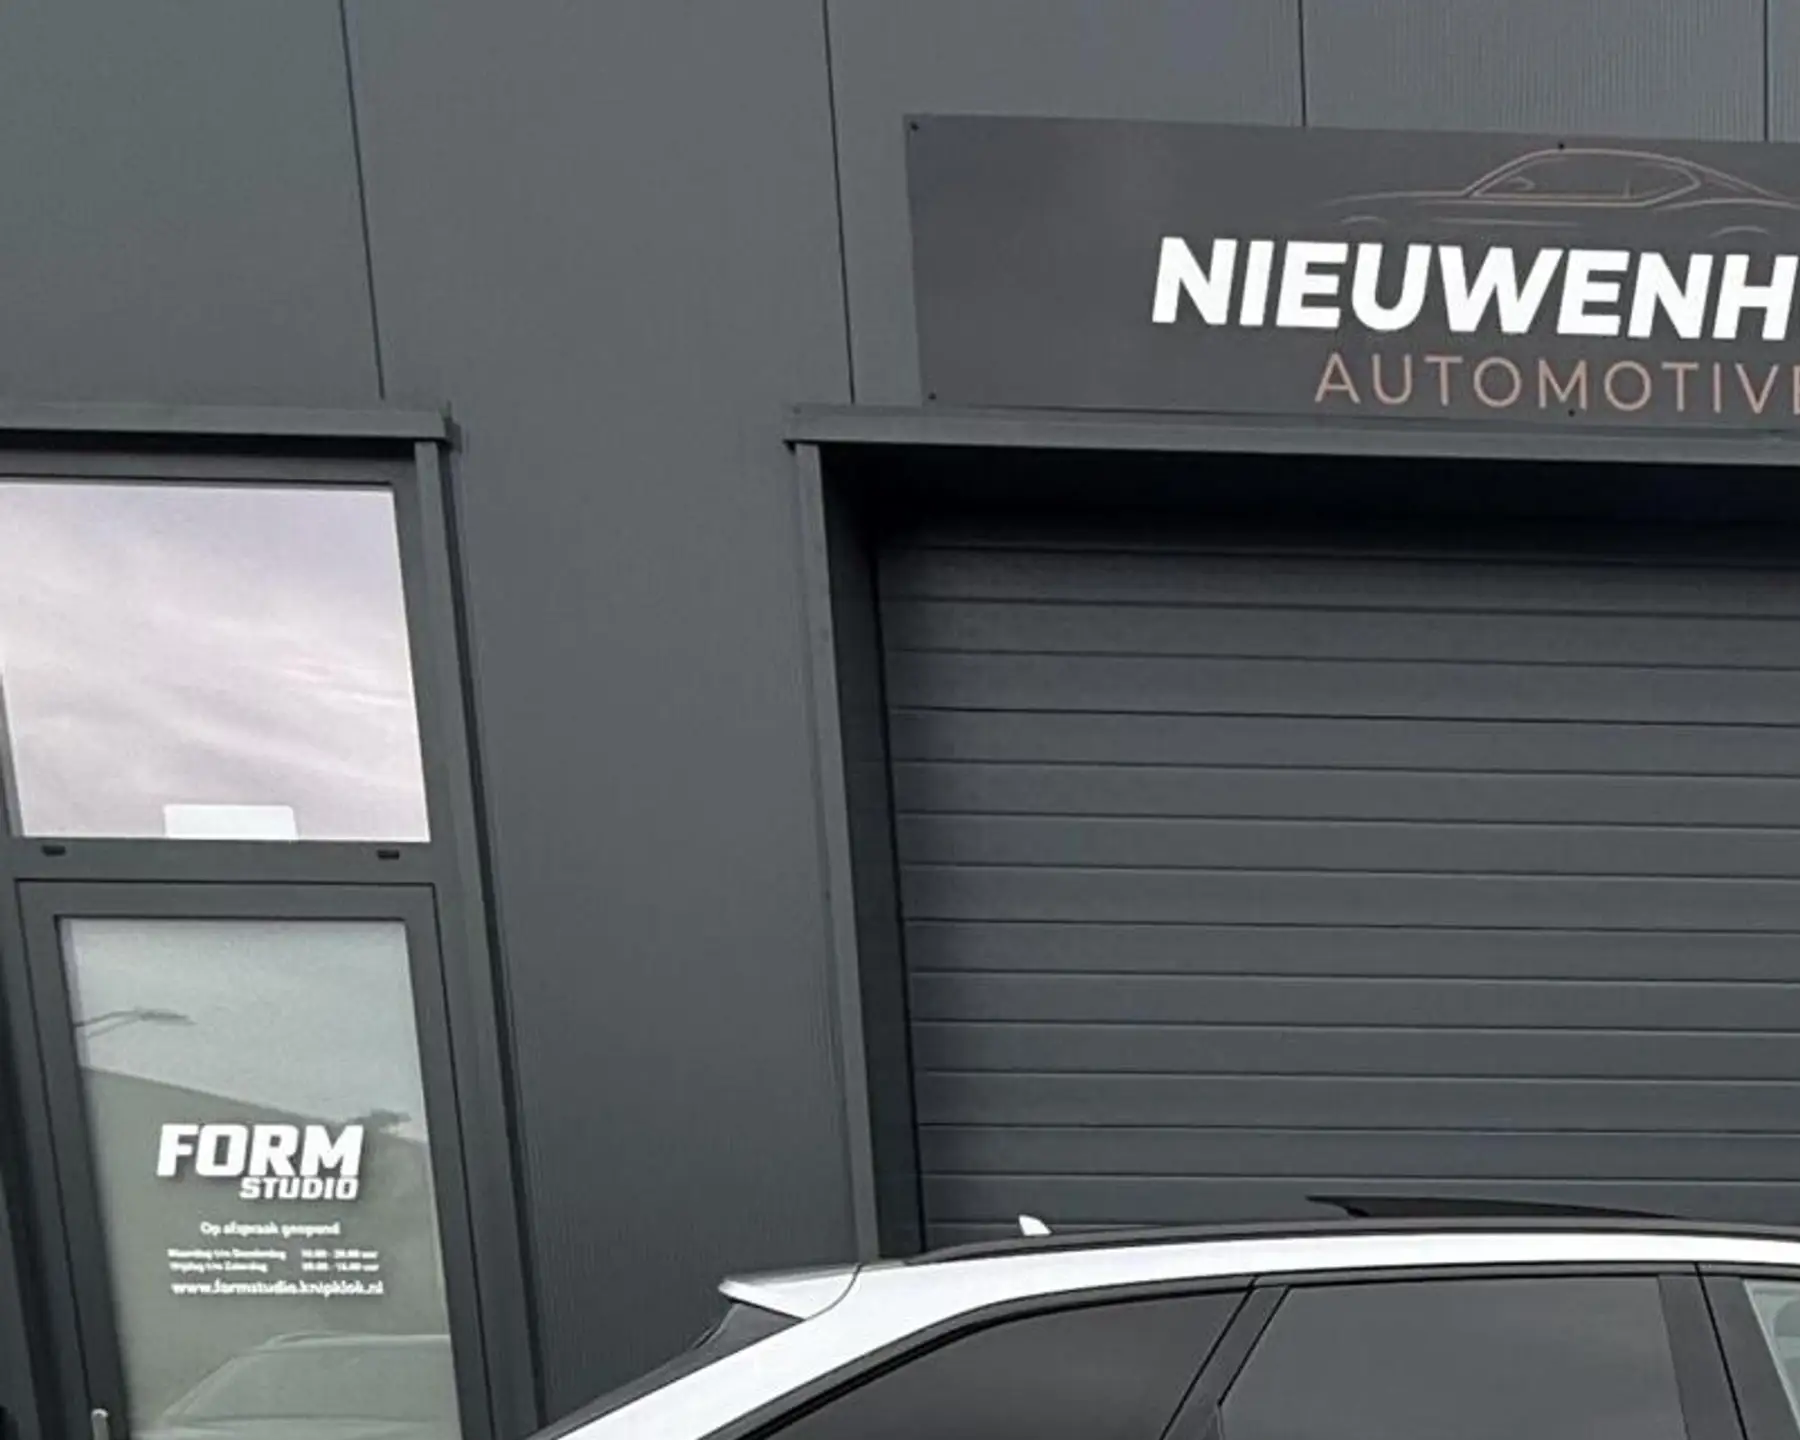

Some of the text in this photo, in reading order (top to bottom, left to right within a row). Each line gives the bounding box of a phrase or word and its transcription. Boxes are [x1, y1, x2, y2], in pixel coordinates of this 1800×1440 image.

[156, 1123, 364, 1177] FORM
[239, 1176, 359, 1200] STUDIO
[200, 1221, 221, 1237] Op
